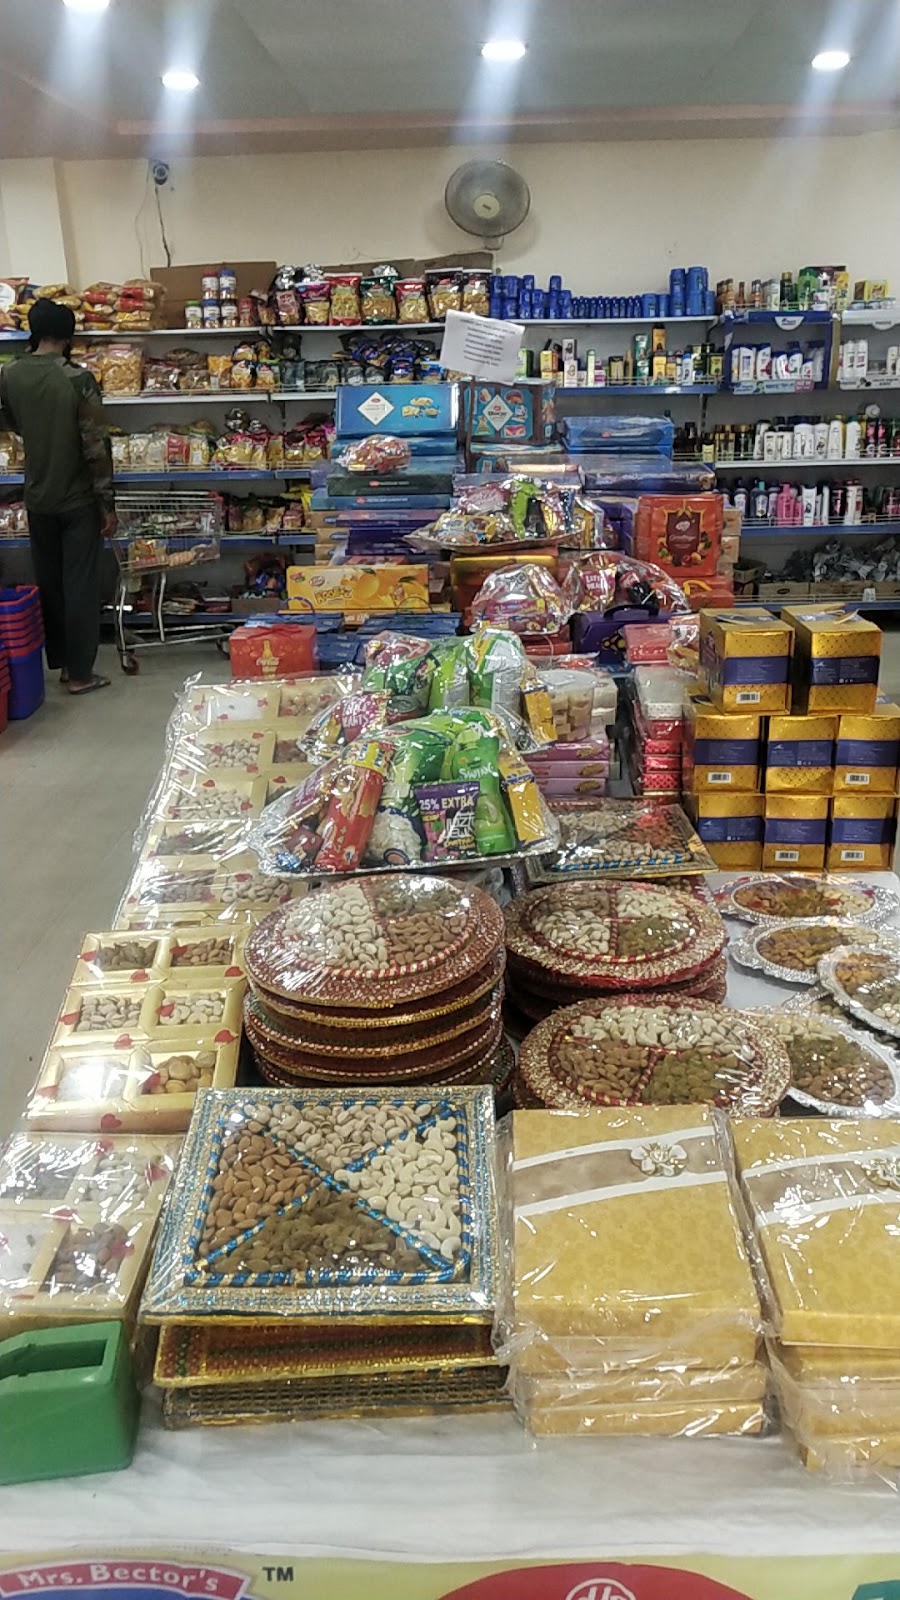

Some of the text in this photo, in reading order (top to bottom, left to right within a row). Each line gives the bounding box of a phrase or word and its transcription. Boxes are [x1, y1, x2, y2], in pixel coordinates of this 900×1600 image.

[418, 794, 475, 811] 25% EXTRA
[17, 1564, 294, 1592] Mrs. Bector's TM
